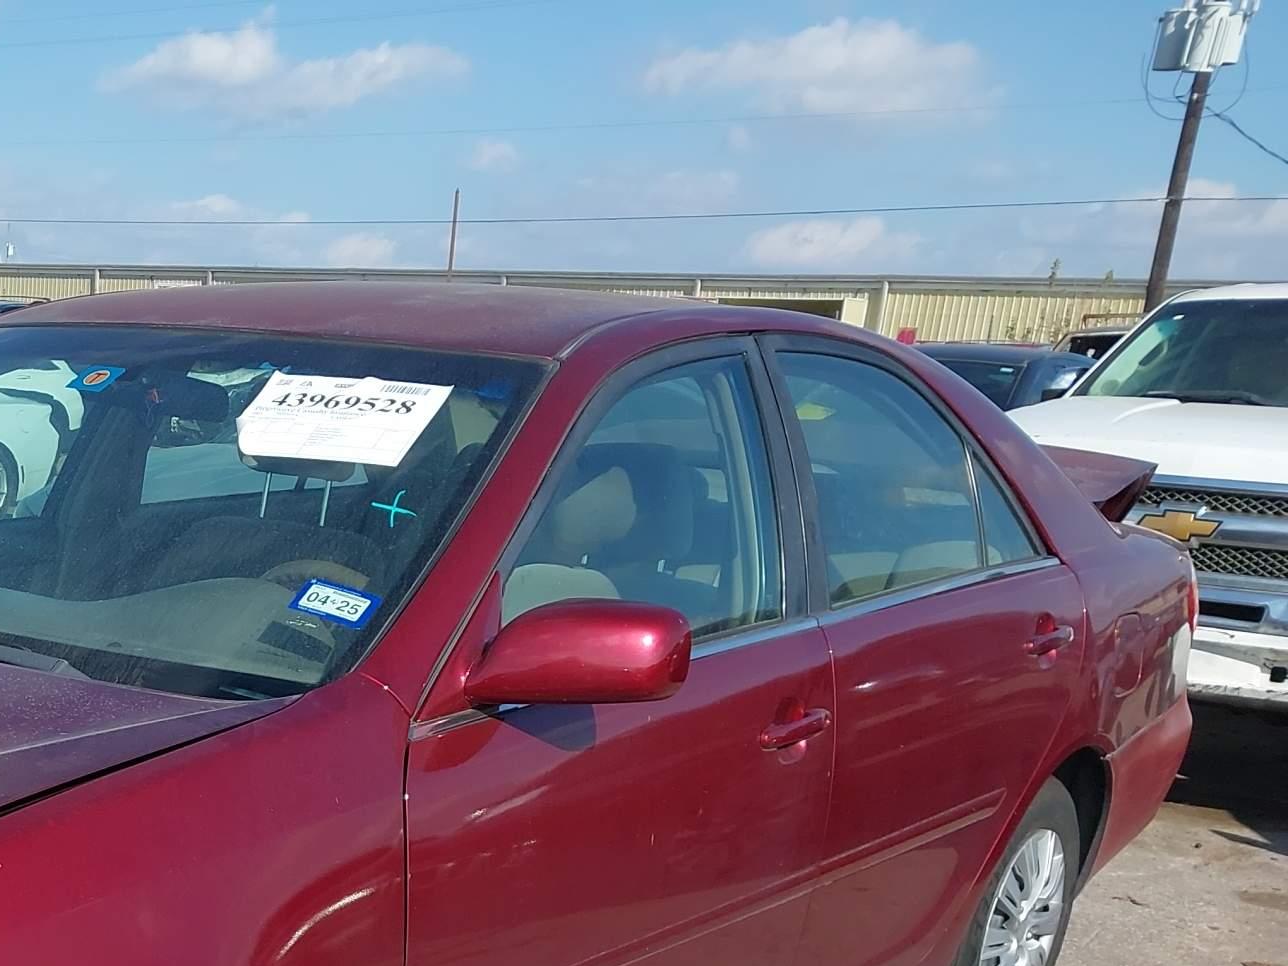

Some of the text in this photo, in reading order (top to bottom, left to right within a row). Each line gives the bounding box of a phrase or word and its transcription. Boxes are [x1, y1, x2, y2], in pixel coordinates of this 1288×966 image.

[271, 391, 416, 415] 43969528
[306, 591, 330, 606] 04
[335, 600, 362, 616] 25
